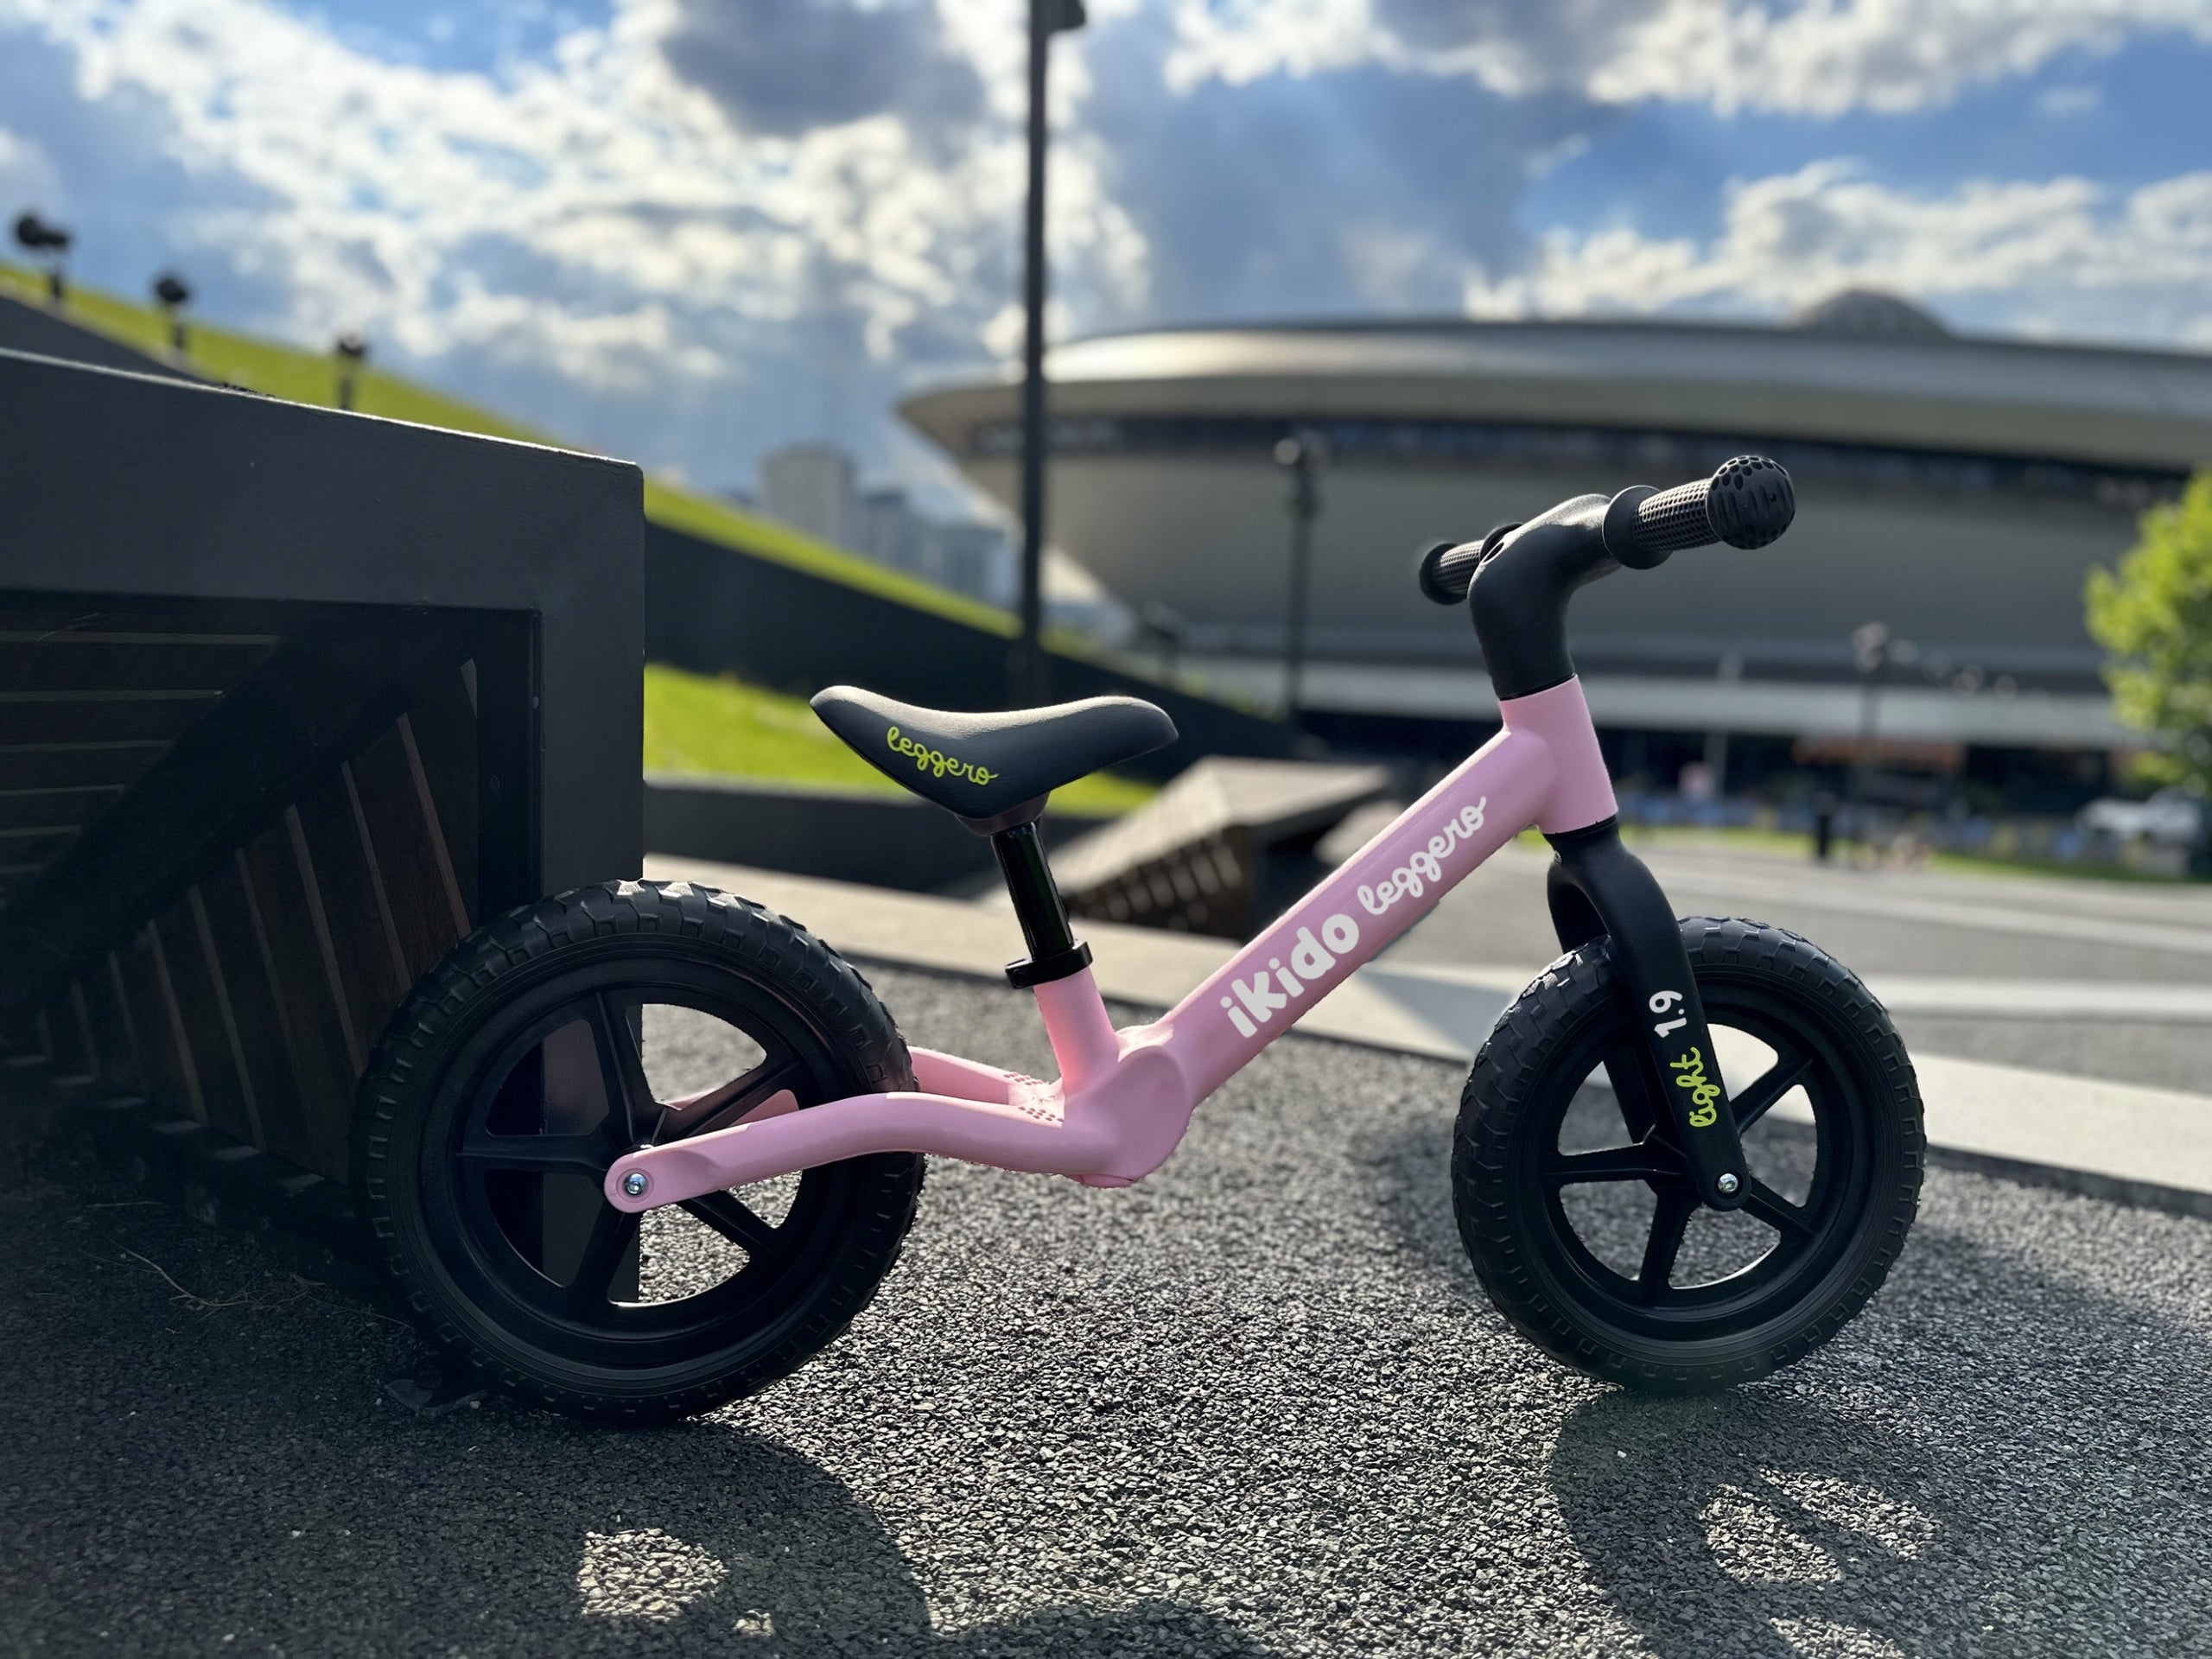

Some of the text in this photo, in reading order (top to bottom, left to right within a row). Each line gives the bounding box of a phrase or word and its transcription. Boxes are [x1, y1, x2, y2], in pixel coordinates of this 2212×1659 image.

[887, 726, 999, 785] leggero
[1357, 796, 1487, 915] leggero
[1649, 990, 1720, 1127] light 1.9
